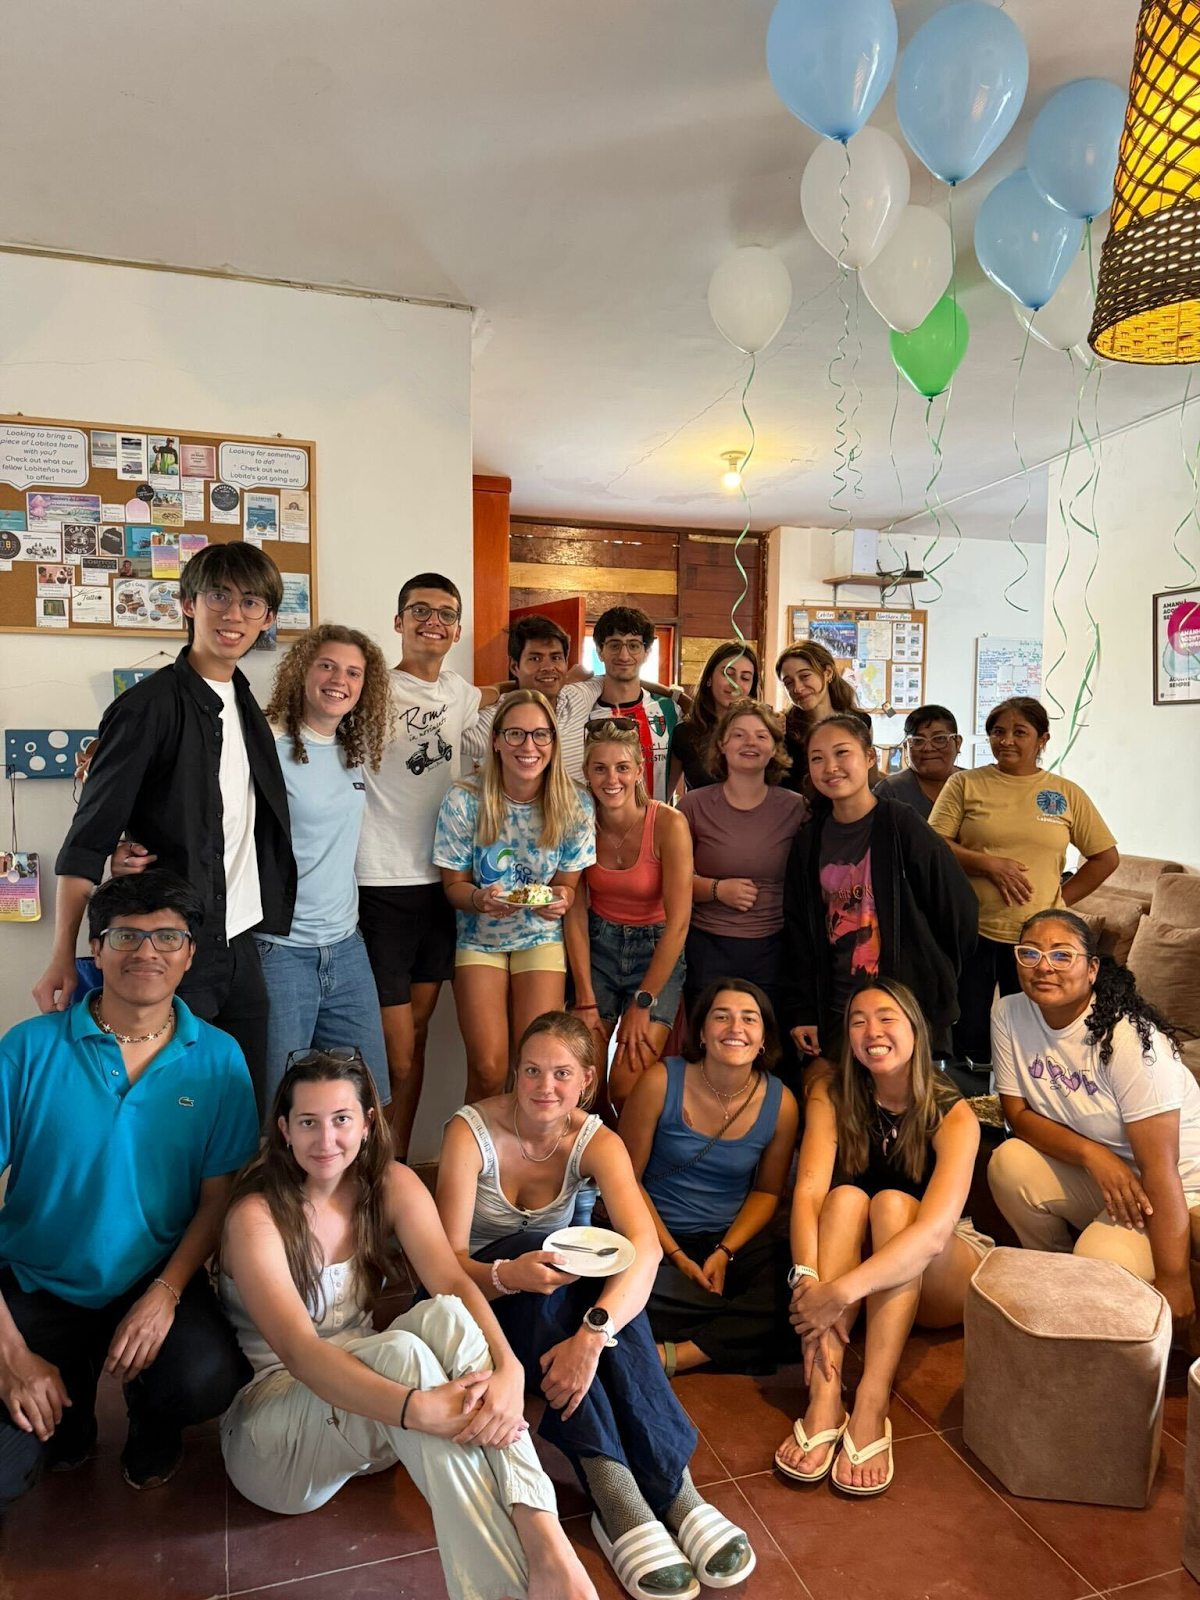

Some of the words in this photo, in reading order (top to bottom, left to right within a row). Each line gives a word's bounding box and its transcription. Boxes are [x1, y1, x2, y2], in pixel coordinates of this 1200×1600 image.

[6, 430, 35, 438] Looking
[46, 432, 66, 440] bring
[59, 441, 79, 449] home
[5, 455, 28, 463] Check
[229, 448, 256, 456] Looking
[267, 451, 301, 460] something
[399, 704, 448, 733] Roma
